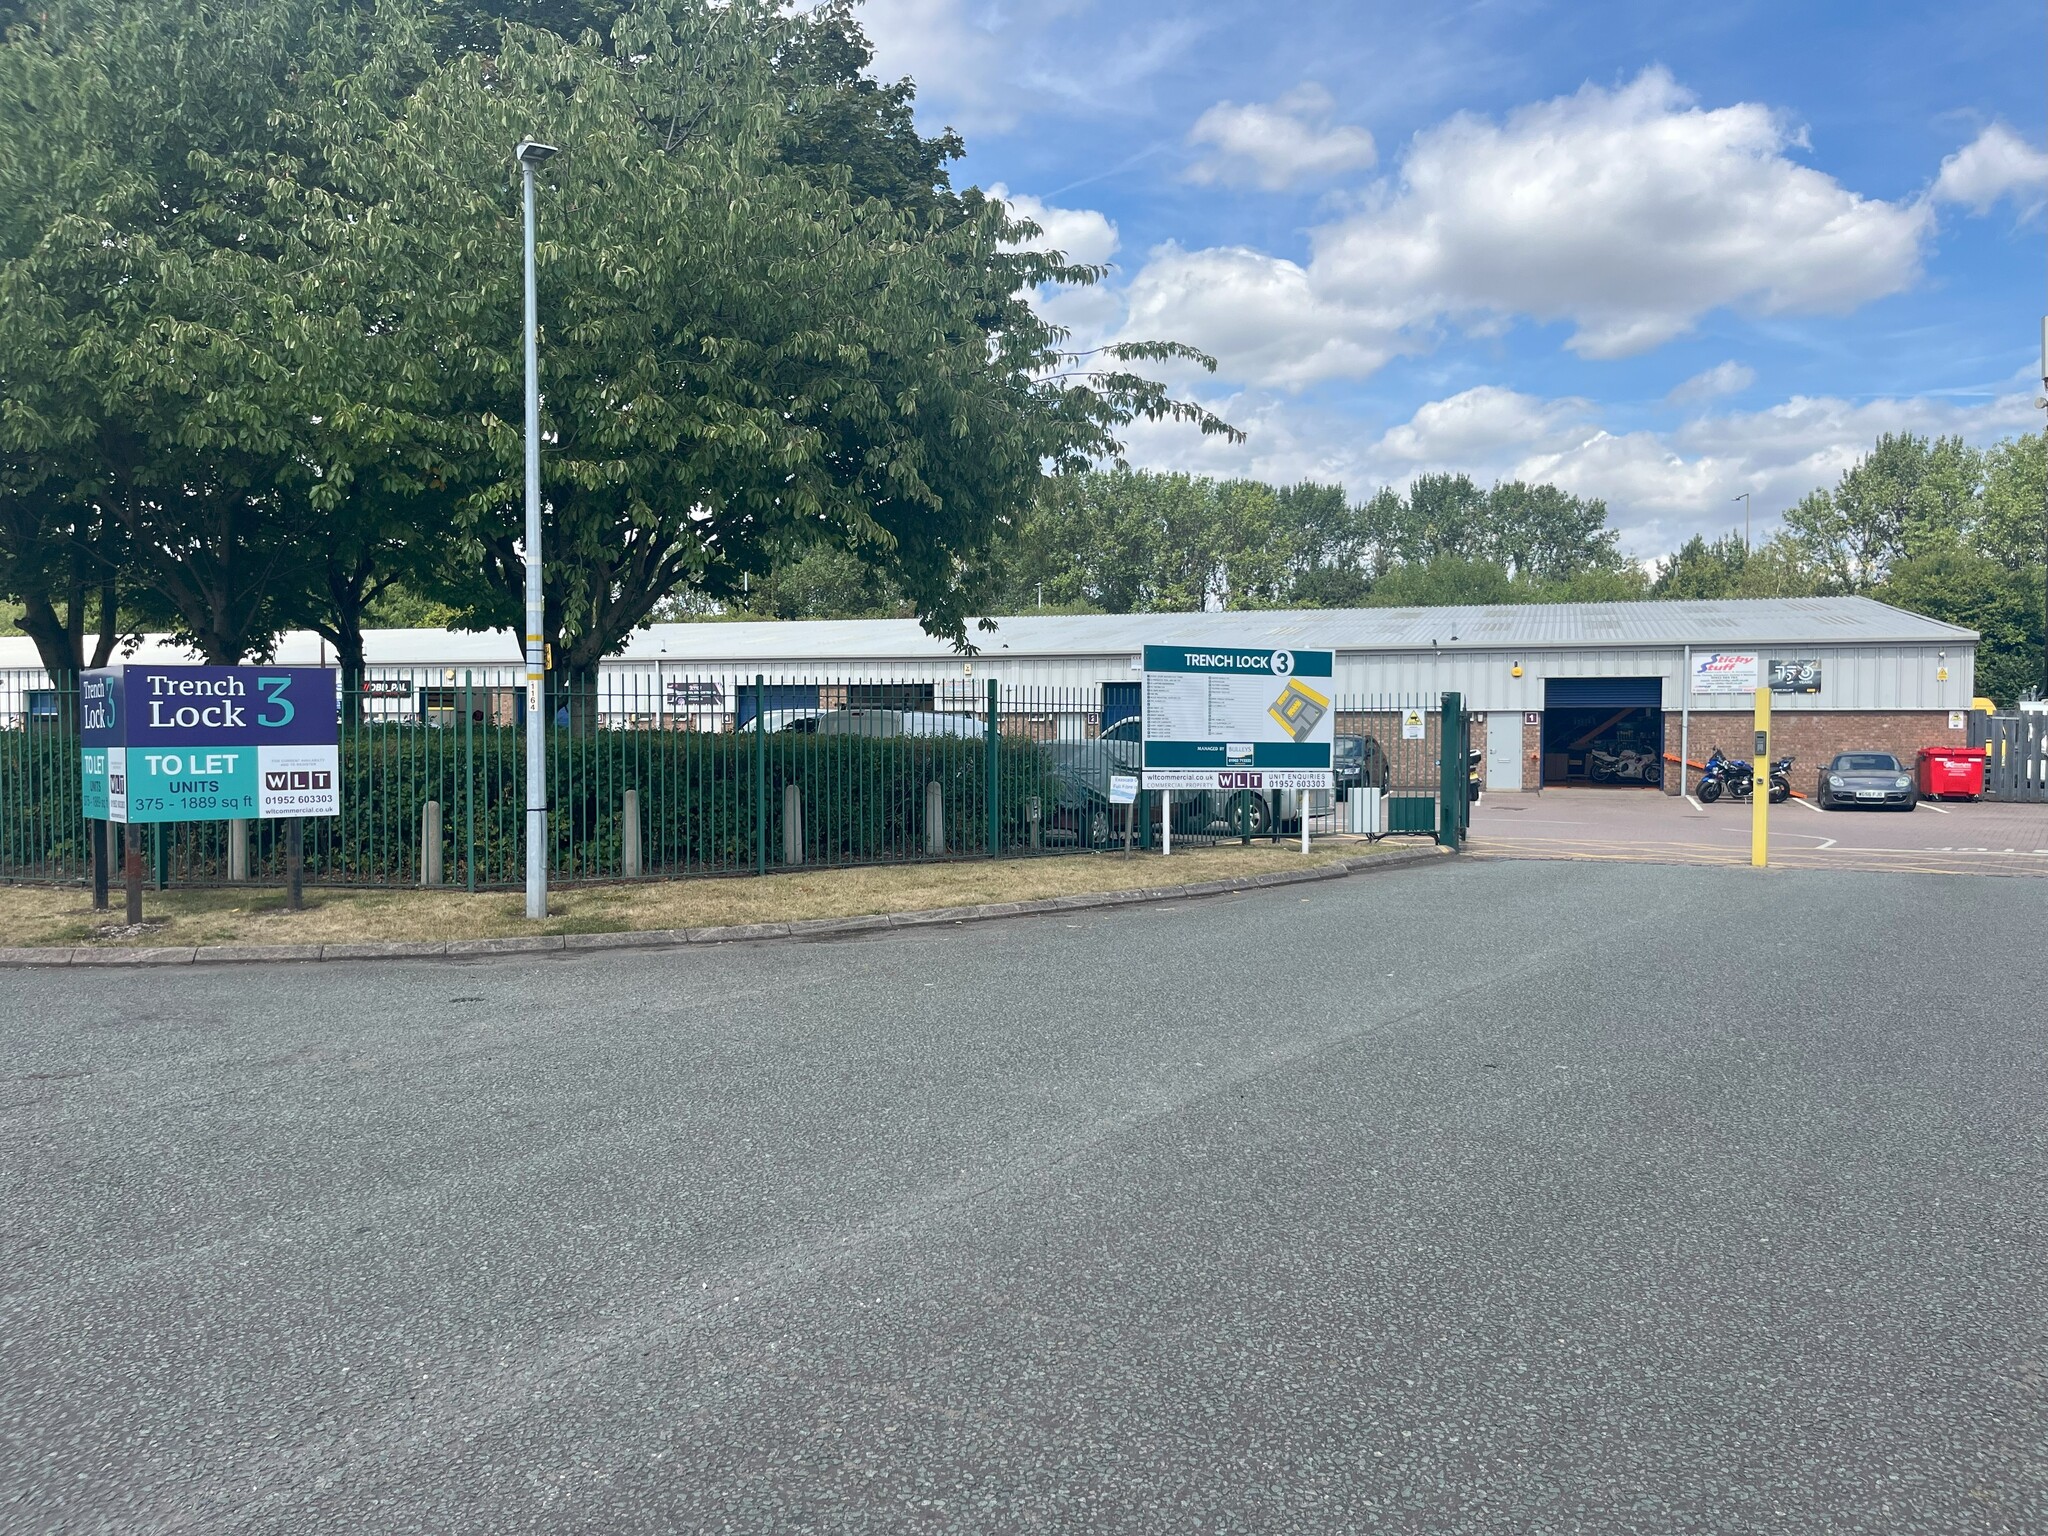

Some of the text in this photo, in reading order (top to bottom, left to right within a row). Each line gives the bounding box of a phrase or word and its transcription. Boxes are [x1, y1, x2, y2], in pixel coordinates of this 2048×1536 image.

[1184, 652, 1289, 674] TRENCH LOCK 3
[1707, 653, 1754, 665] Sticky
[1697, 663, 1736, 673] Stuff
[83, 676, 116, 728] Trench 3
[146, 675, 295, 728] Trench 3
[84, 701, 106, 729] Lock
[149, 699, 247, 728] Lock
[1528, 714, 1534, 722] 1
[84, 755, 105, 775] TO LET
[145, 754, 239, 776] TO LET
[169, 780, 220, 794] UNITS
[266, 771, 330, 790] WLT
[1147, 773, 1214, 782] wltcommercial.co.uk
[1219, 774, 1262, 787] WLT
[1269, 780, 1294, 788] 01952
[1297, 780, 1326, 788] 603303
[135, 798, 164, 811] 375
[182, 796, 217, 810] 1889
[221, 799, 239, 811] sq
[243, 795, 253, 808] ft
[265, 794, 333, 805] 01952 603303
[265, 806, 333, 815] wltcommercial.co.uk
